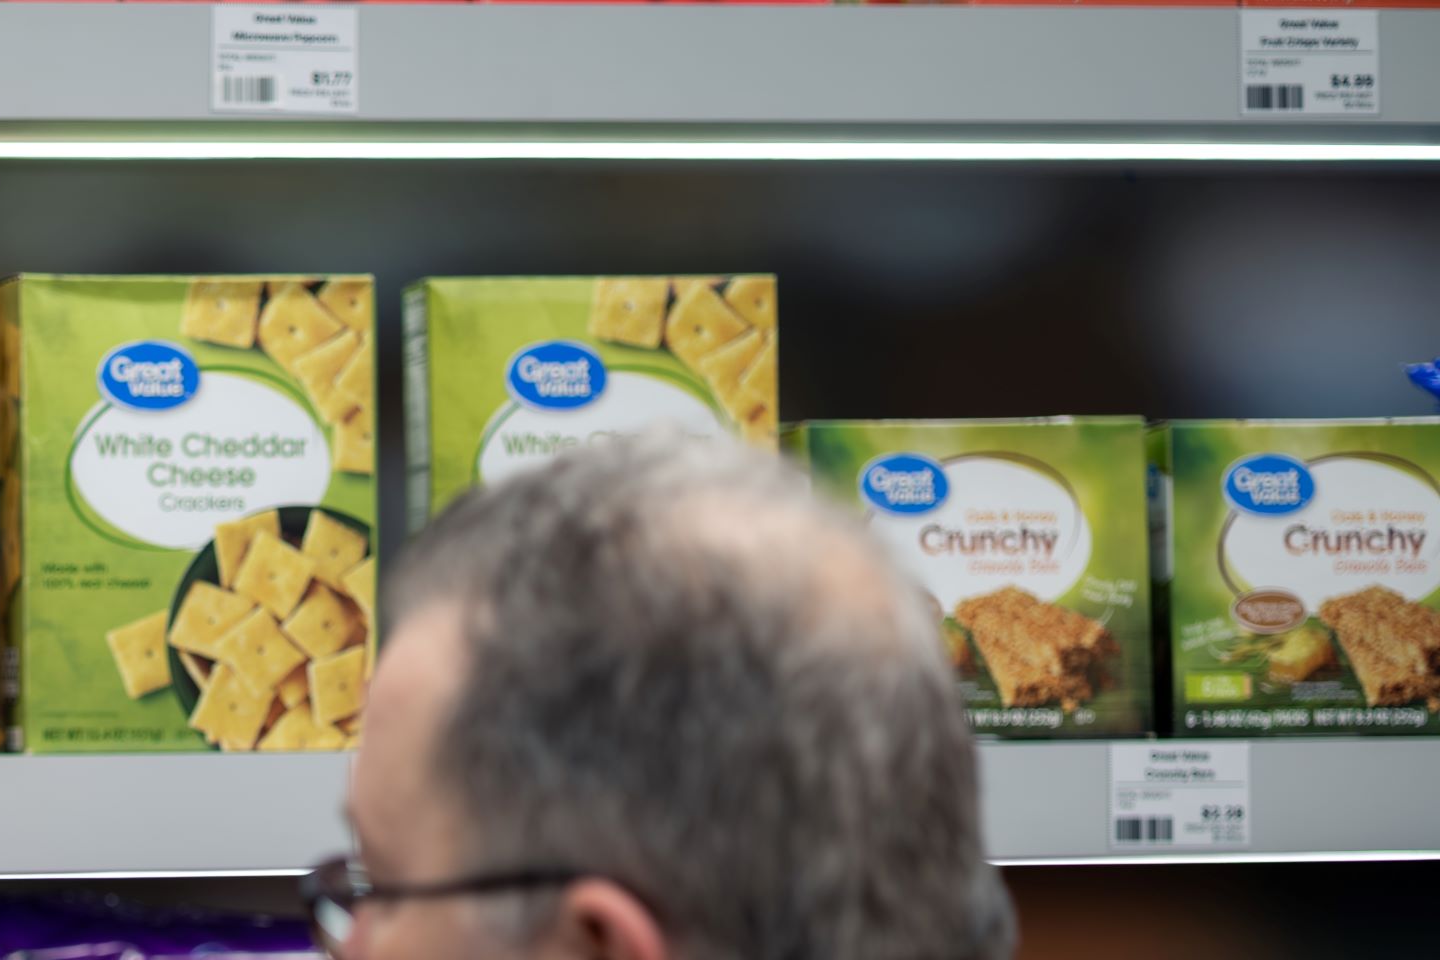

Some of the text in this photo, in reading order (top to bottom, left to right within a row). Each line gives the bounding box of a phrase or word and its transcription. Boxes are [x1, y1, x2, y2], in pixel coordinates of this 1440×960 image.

[110, 356, 186, 398] Great Value
[517, 355, 591, 398] Great Value
[95, 433, 306, 459] White Cheddar
[147, 461, 256, 488] Cheese
[868, 466, 936, 505] Great Value
[1233, 466, 1300, 504] Great Value
[159, 492, 245, 513] Crackers
[919, 524, 1058, 558] Crunchy
[1283, 524, 1426, 558] Crunchy
